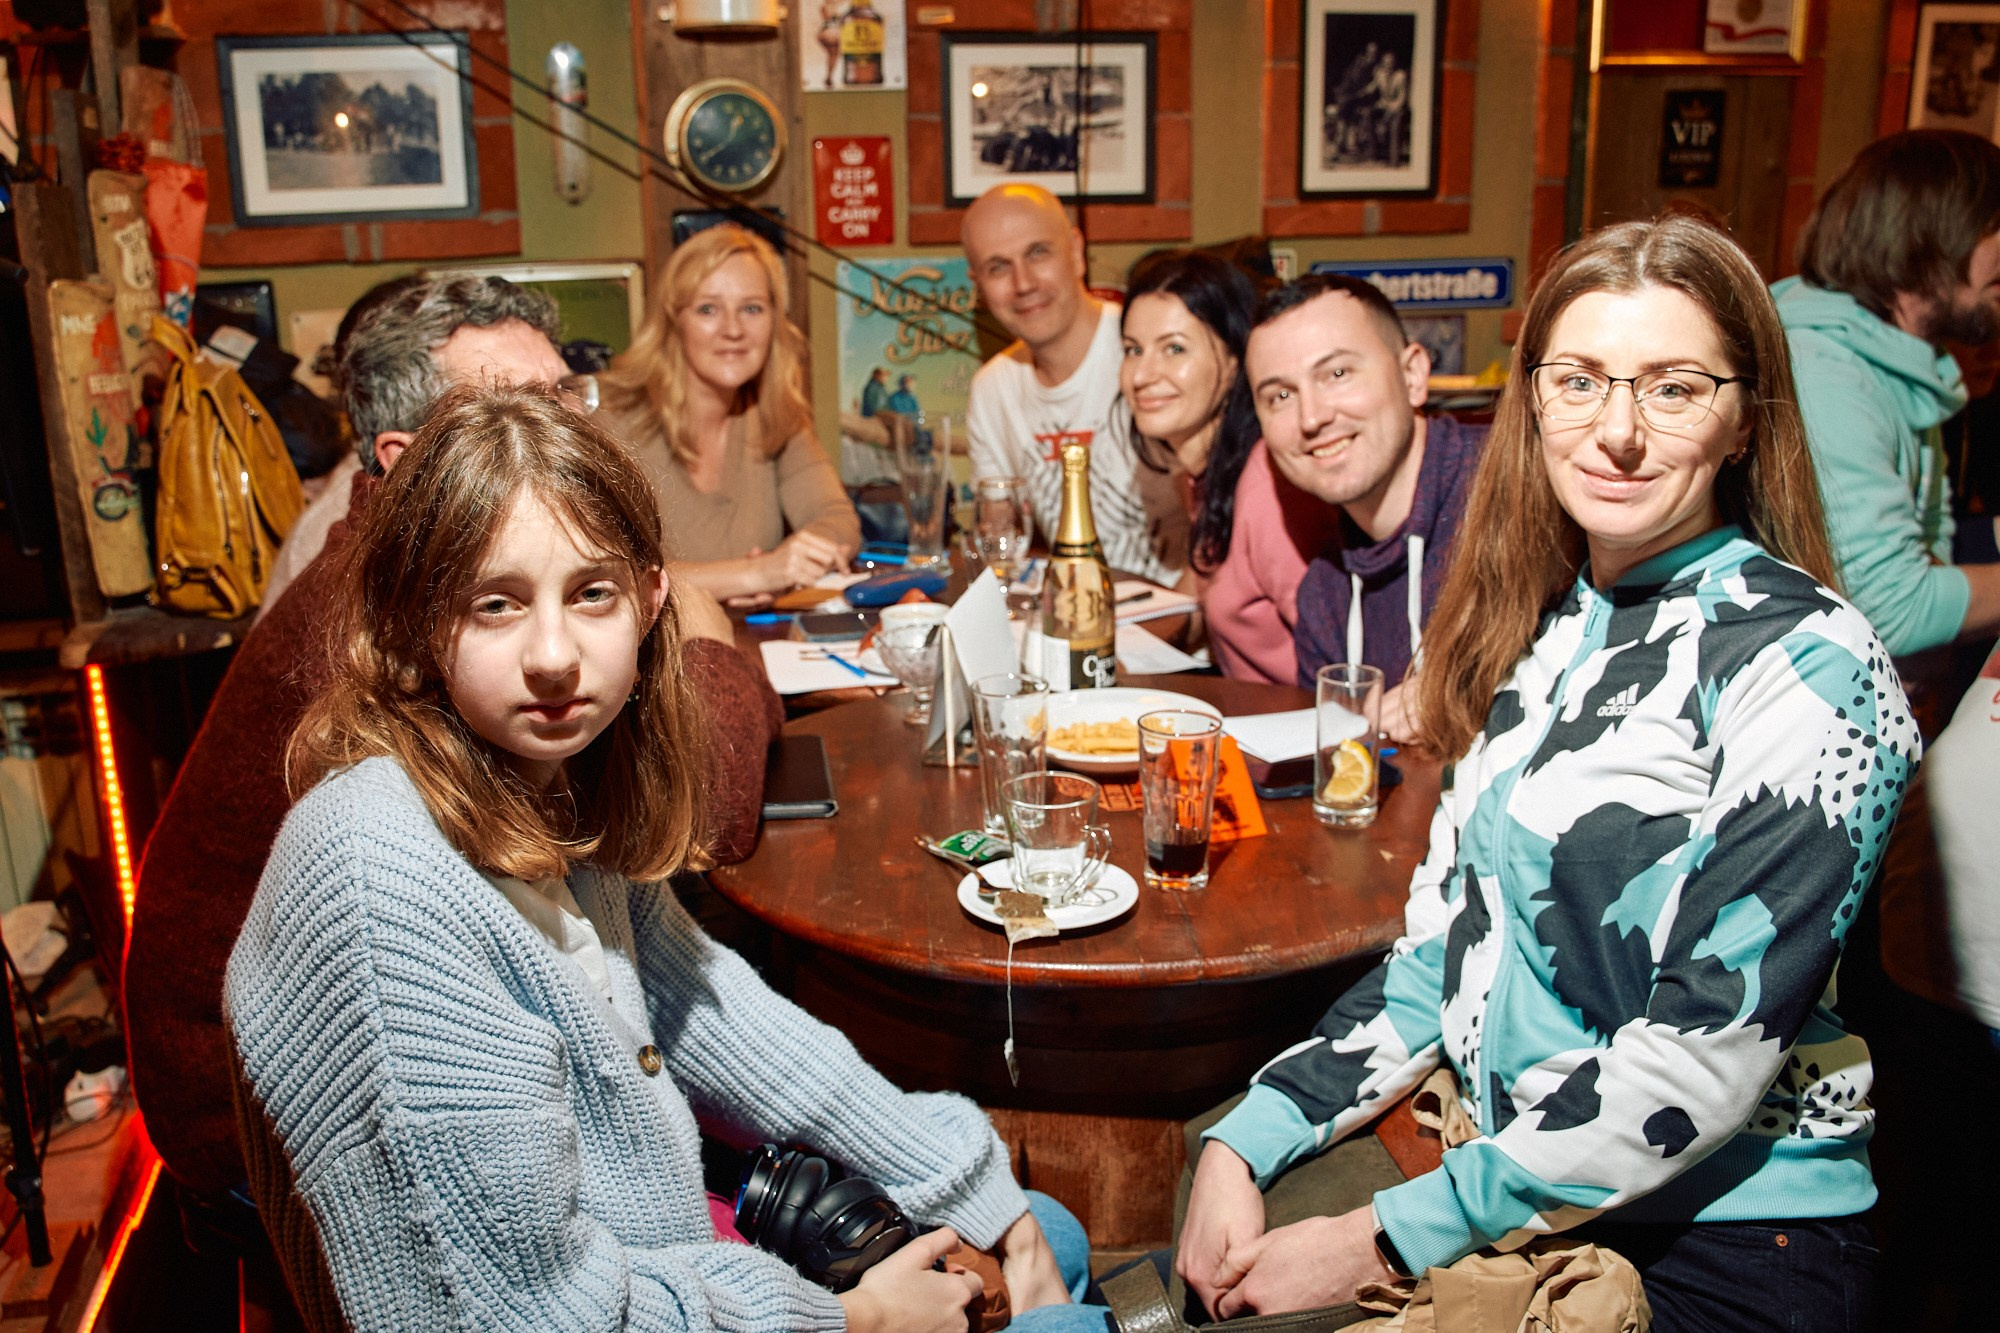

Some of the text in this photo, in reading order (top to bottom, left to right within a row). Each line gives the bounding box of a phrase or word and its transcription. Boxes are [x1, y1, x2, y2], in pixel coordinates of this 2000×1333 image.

[1671, 121, 1717, 146] VIP
[833, 166, 875, 182] KEEP
[830, 182, 878, 198] CALM
[828, 206, 881, 223] CARRY
[842, 222, 870, 238] ON
[1366, 268, 1498, 301] bertstraße
